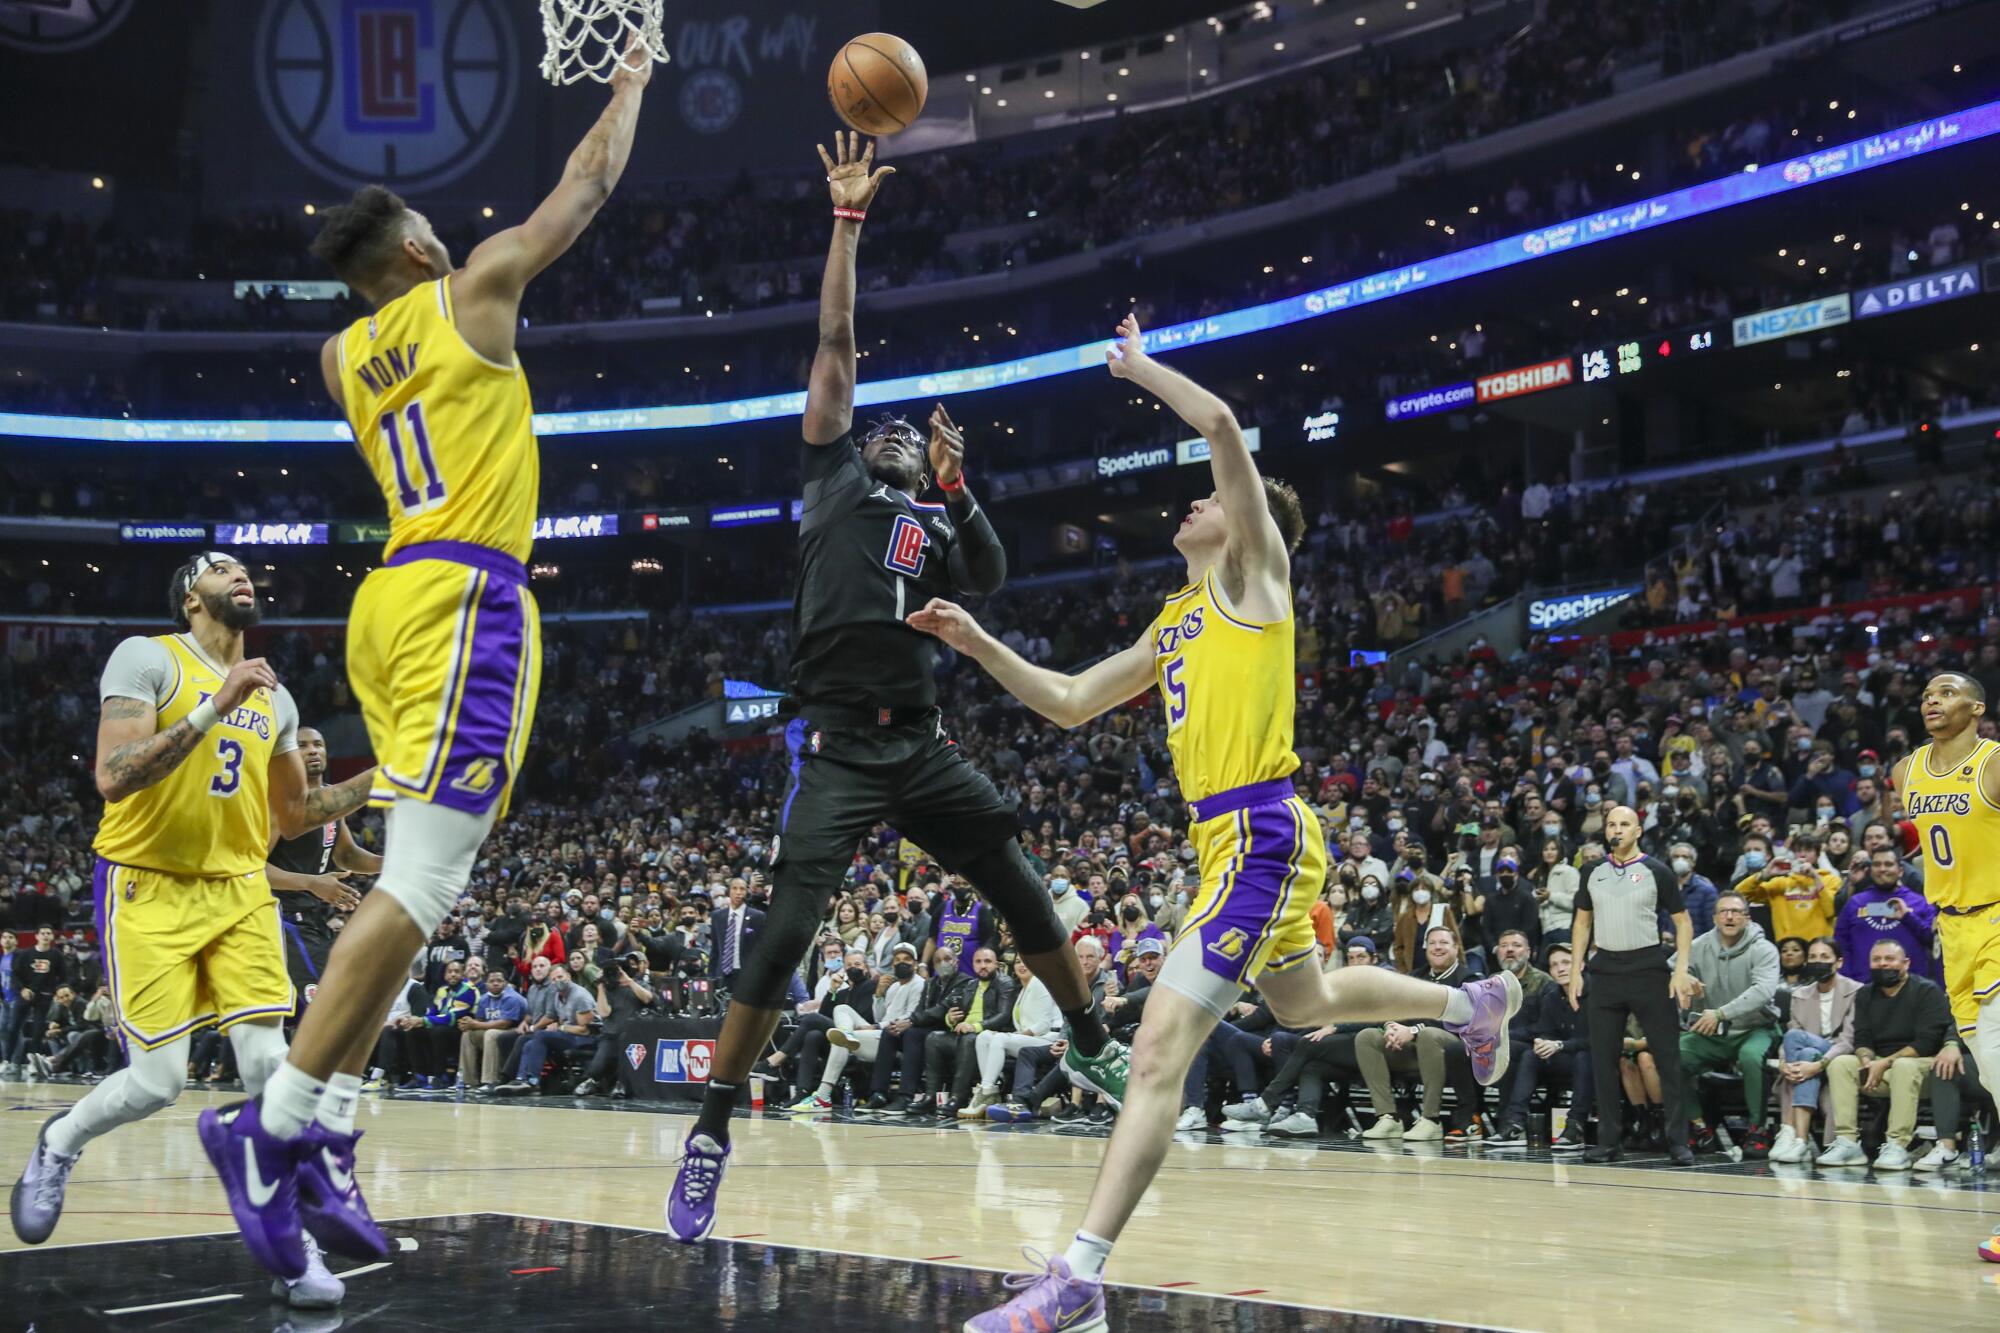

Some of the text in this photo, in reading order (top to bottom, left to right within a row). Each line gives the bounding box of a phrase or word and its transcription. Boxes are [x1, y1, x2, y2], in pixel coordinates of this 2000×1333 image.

[1887, 271, 1976, 307] DELTA
[1658, 340, 1671, 357] 4
[356, 342, 420, 399] MONK
[1478, 363, 1571, 398] TOSHIBA
[1399, 386, 1476, 413] crypto.com
[380, 400, 446, 518] 11
[1097, 448, 1169, 478] Spectrum
[134, 526, 206, 540] crypto.com
[658, 516, 690, 526] TOYOTA
[895, 575, 905, 621] 1
[209, 736, 245, 798] 3
[1907, 791, 1971, 820] LAKERS
[1929, 823, 1955, 867] 0
